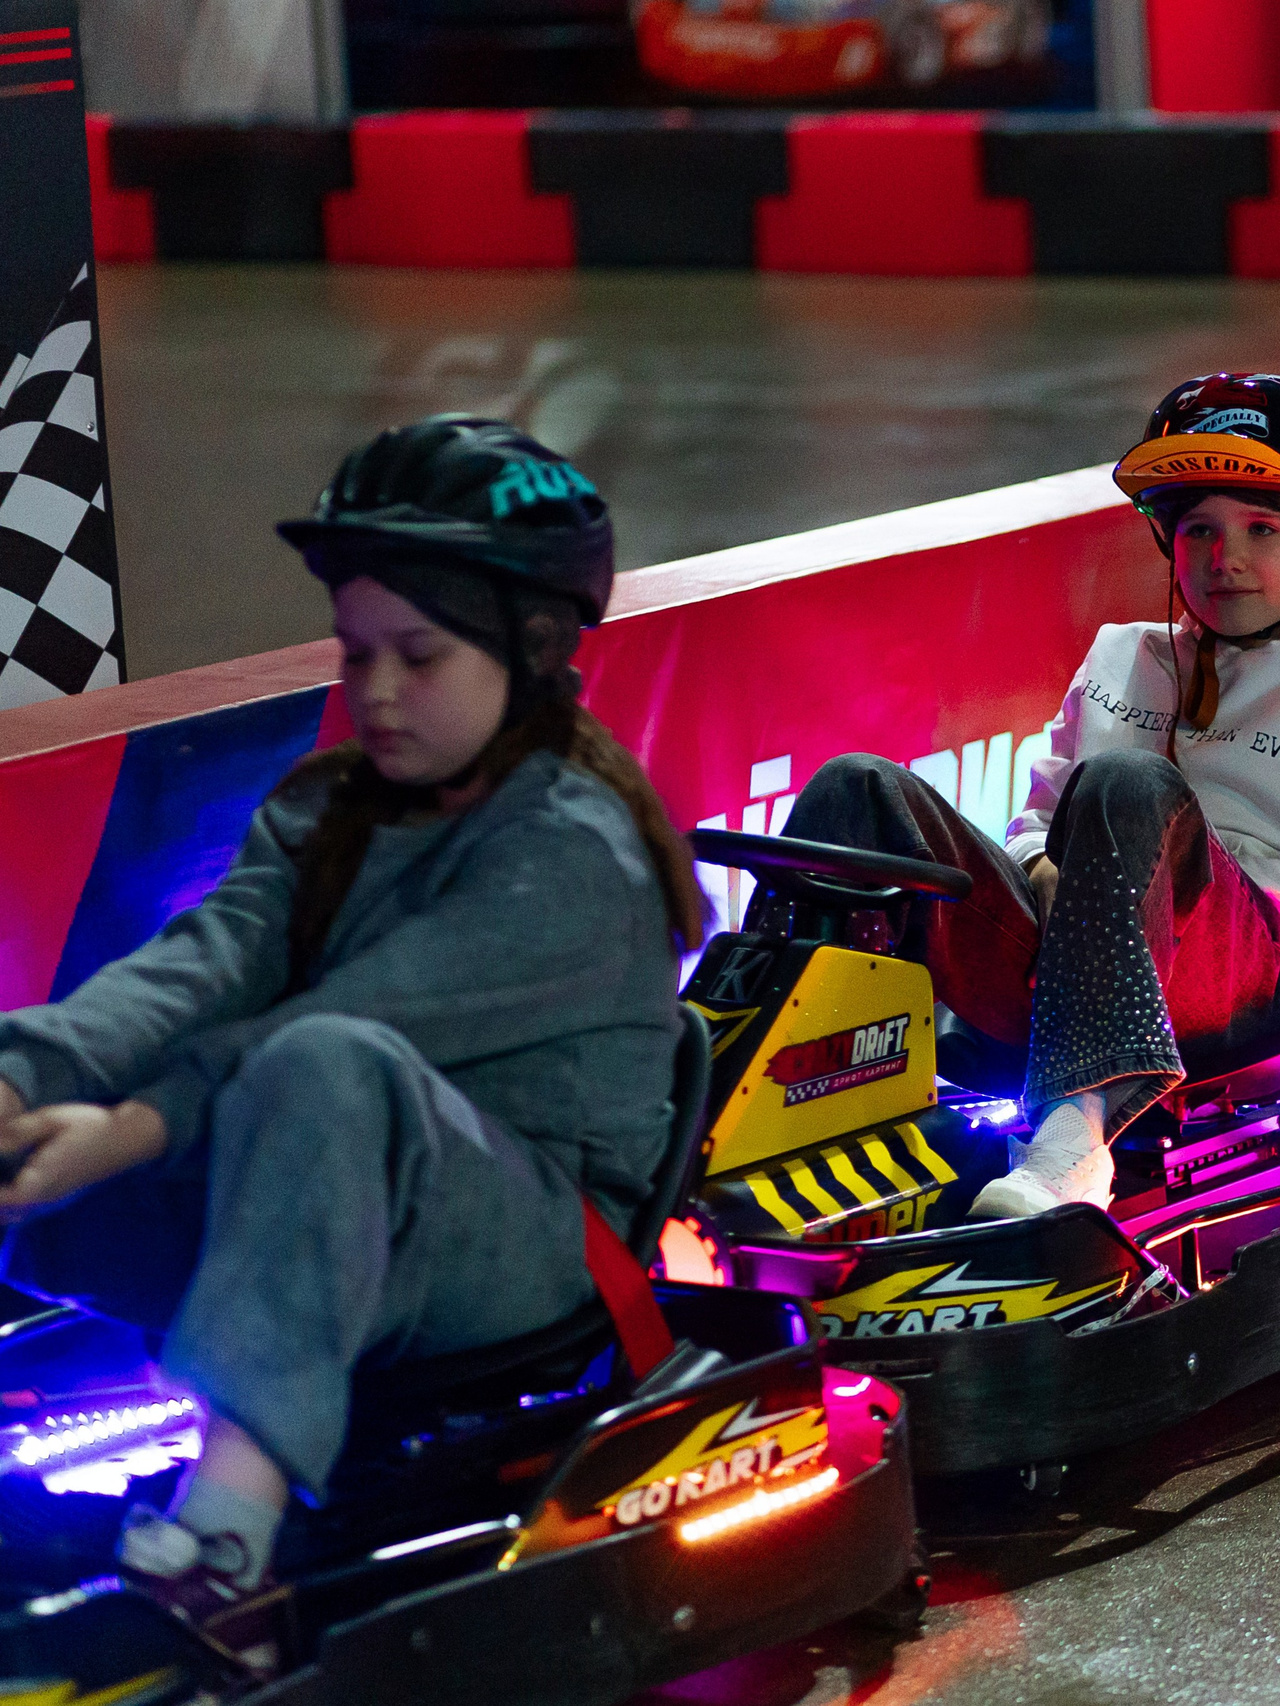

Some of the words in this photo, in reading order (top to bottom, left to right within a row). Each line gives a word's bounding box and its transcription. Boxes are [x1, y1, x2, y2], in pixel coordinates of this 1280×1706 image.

[1082, 679, 1178, 732] HAPPIER
[1186, 724, 1240, 743] THAN
[865, 1060, 901, 1077] КАРТИНГ
[616, 1482, 672, 1525] GO
[675, 1437, 779, 1506] KART
